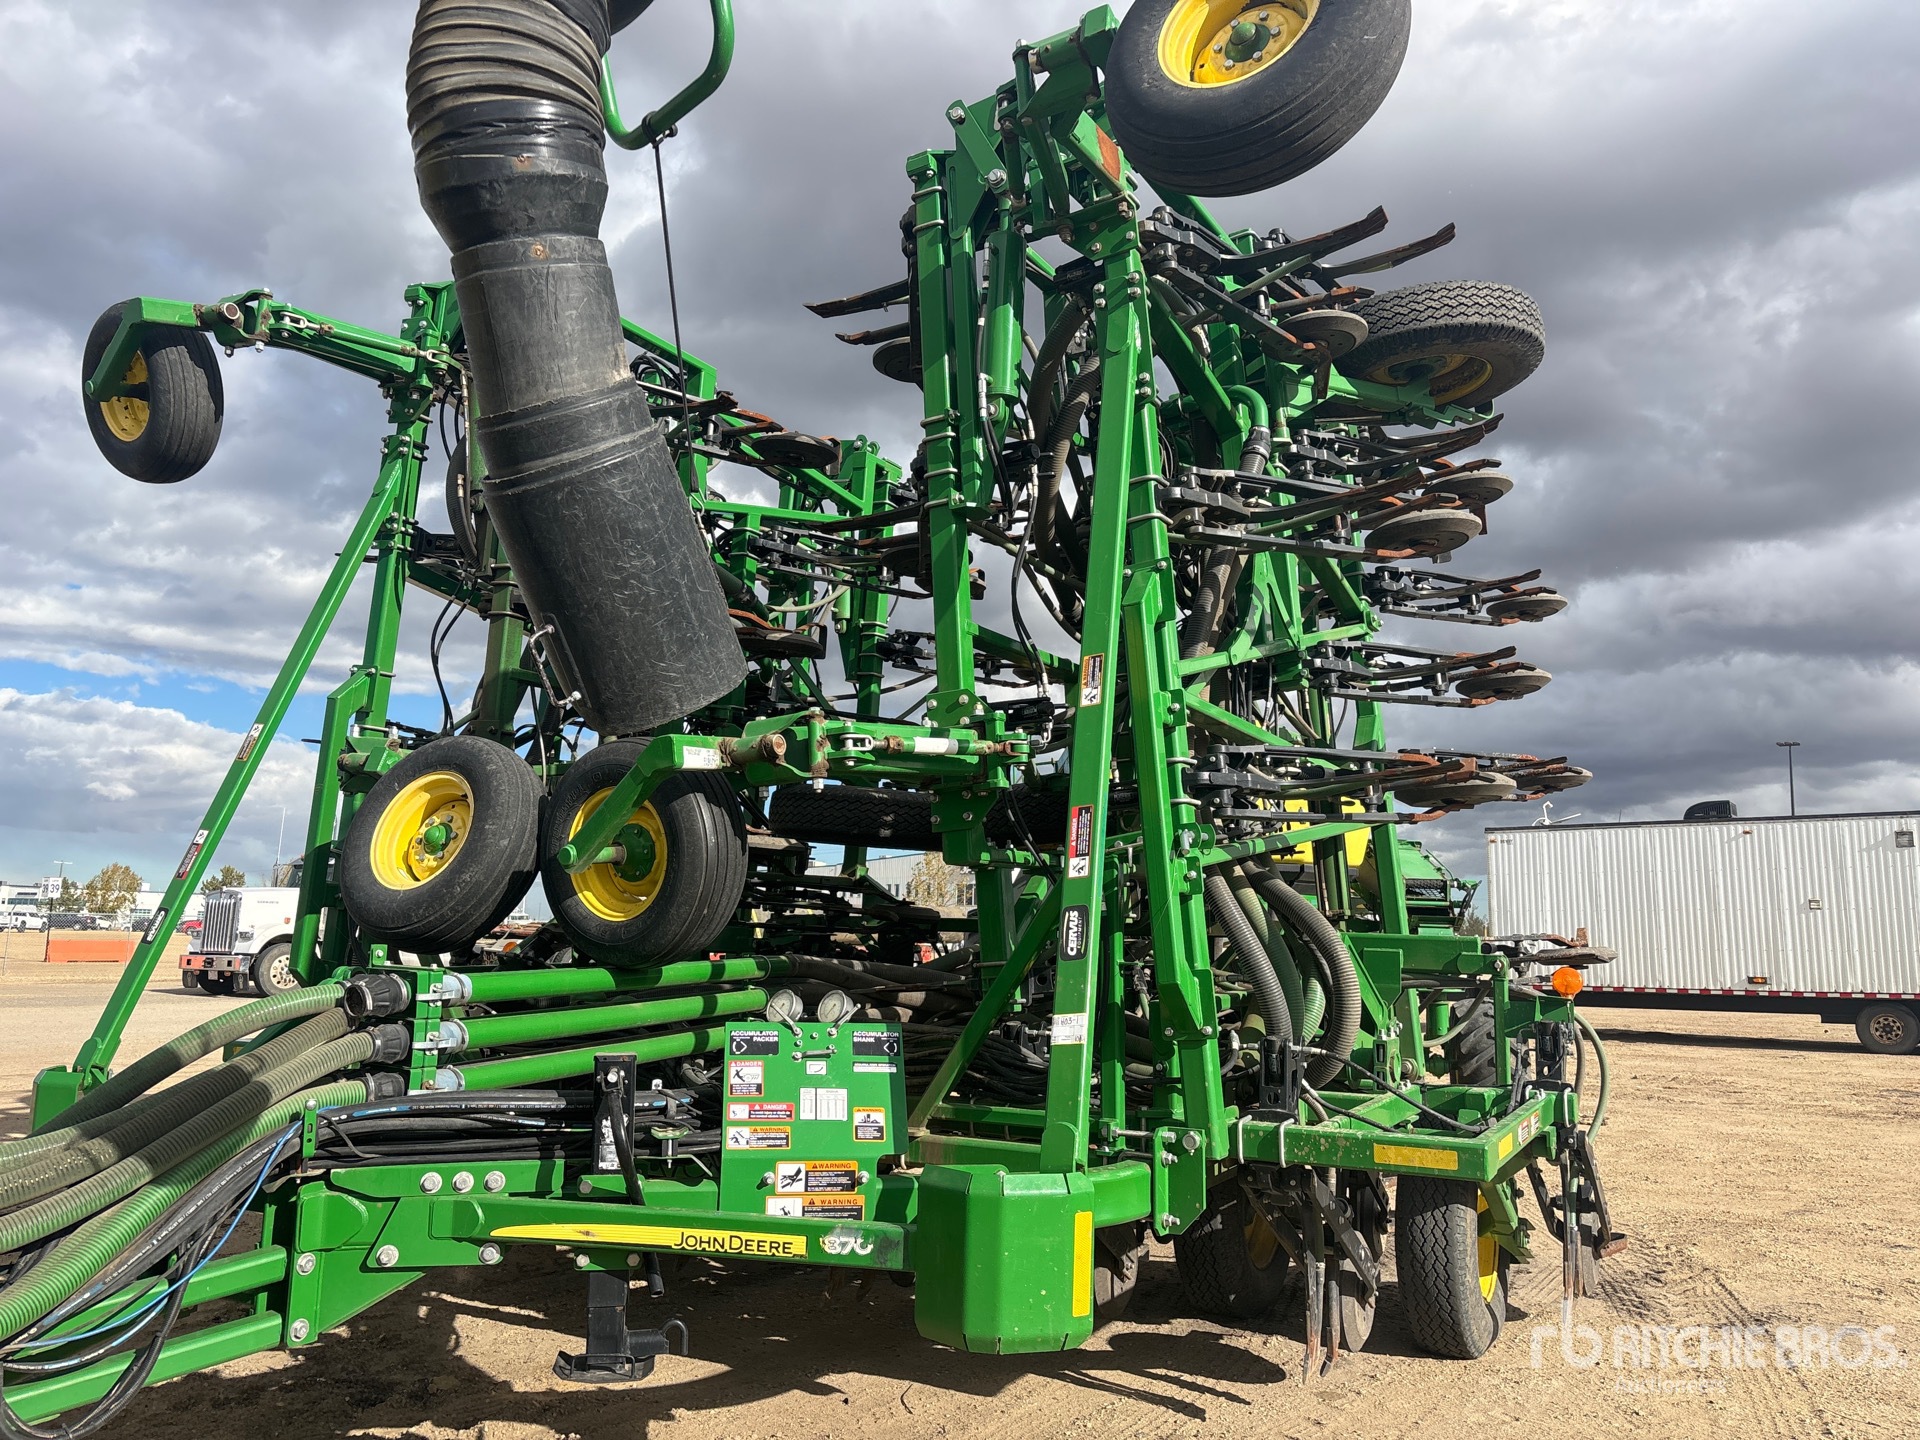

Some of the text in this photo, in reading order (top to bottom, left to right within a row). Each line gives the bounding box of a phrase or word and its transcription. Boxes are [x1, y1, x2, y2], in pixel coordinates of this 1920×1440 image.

[50, 884, 60, 893] 39
[1067, 910, 1079, 956] CERVUS
[674, 1232, 793, 1255] JOHN DEERE
